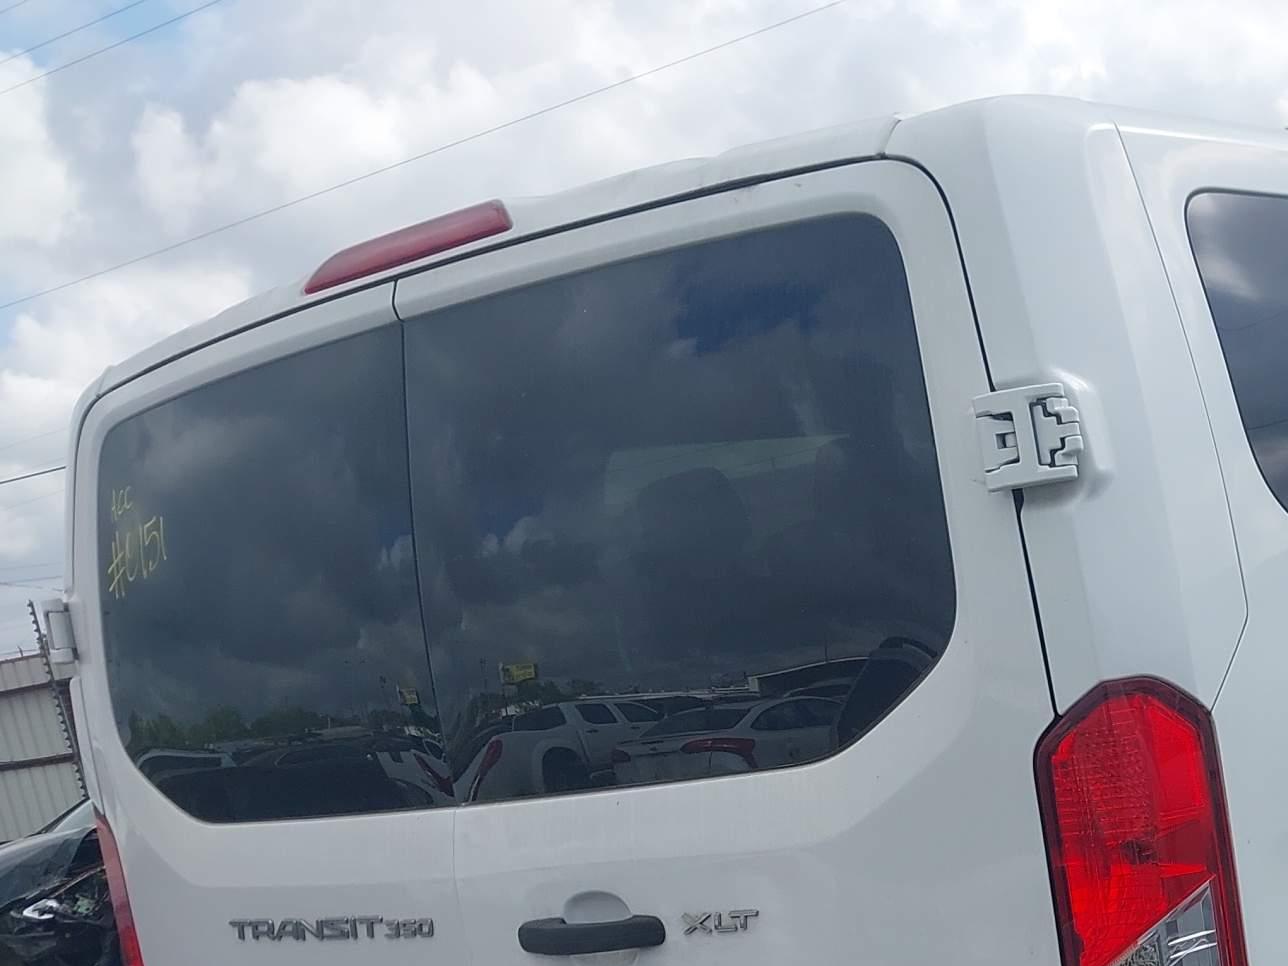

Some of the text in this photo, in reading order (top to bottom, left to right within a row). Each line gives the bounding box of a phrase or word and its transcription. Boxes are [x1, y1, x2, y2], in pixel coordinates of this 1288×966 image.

[228, 914, 435, 942] TRANSIT 350
[680, 909, 760, 936] XLT
